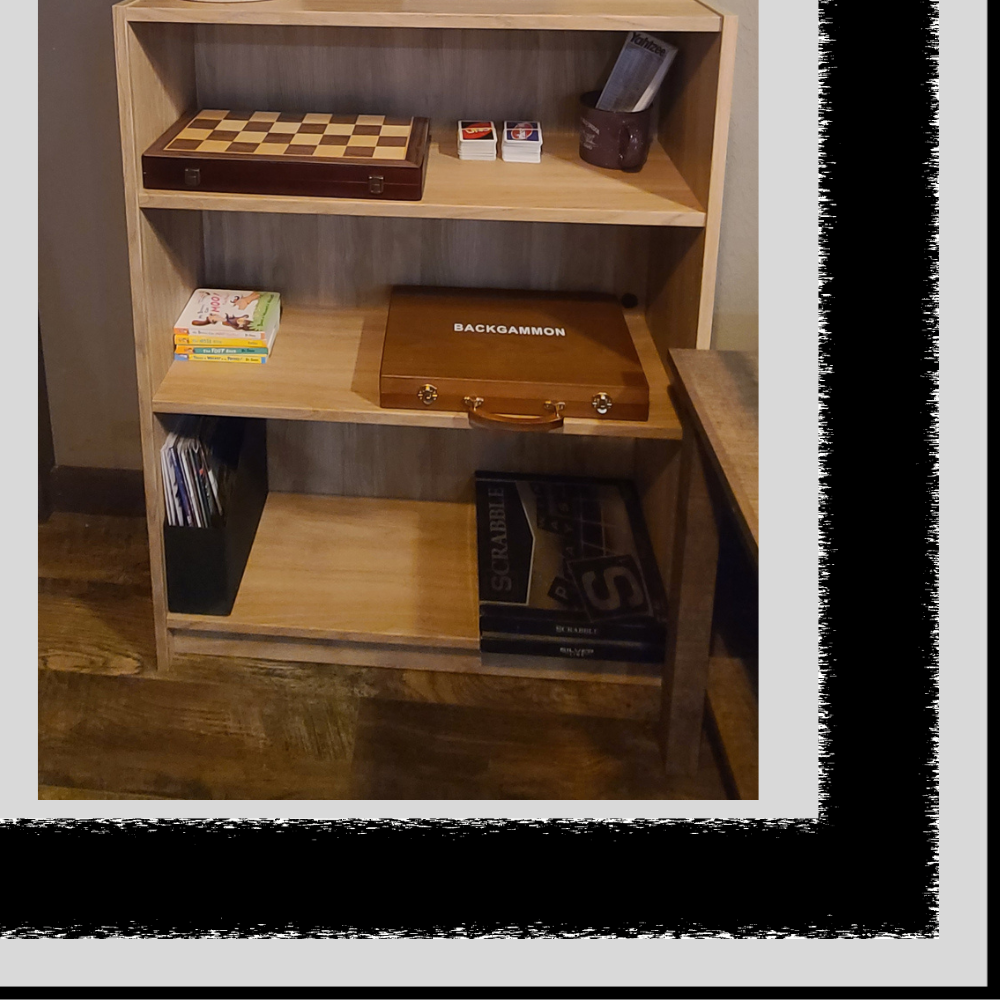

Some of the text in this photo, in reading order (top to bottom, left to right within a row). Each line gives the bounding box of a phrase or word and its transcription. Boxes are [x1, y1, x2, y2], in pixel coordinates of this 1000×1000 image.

[631, 32, 666, 57] Yahtzee
[453, 323, 566, 336] BACKGAMMON
[488, 487, 512, 592] SCRABBLE
